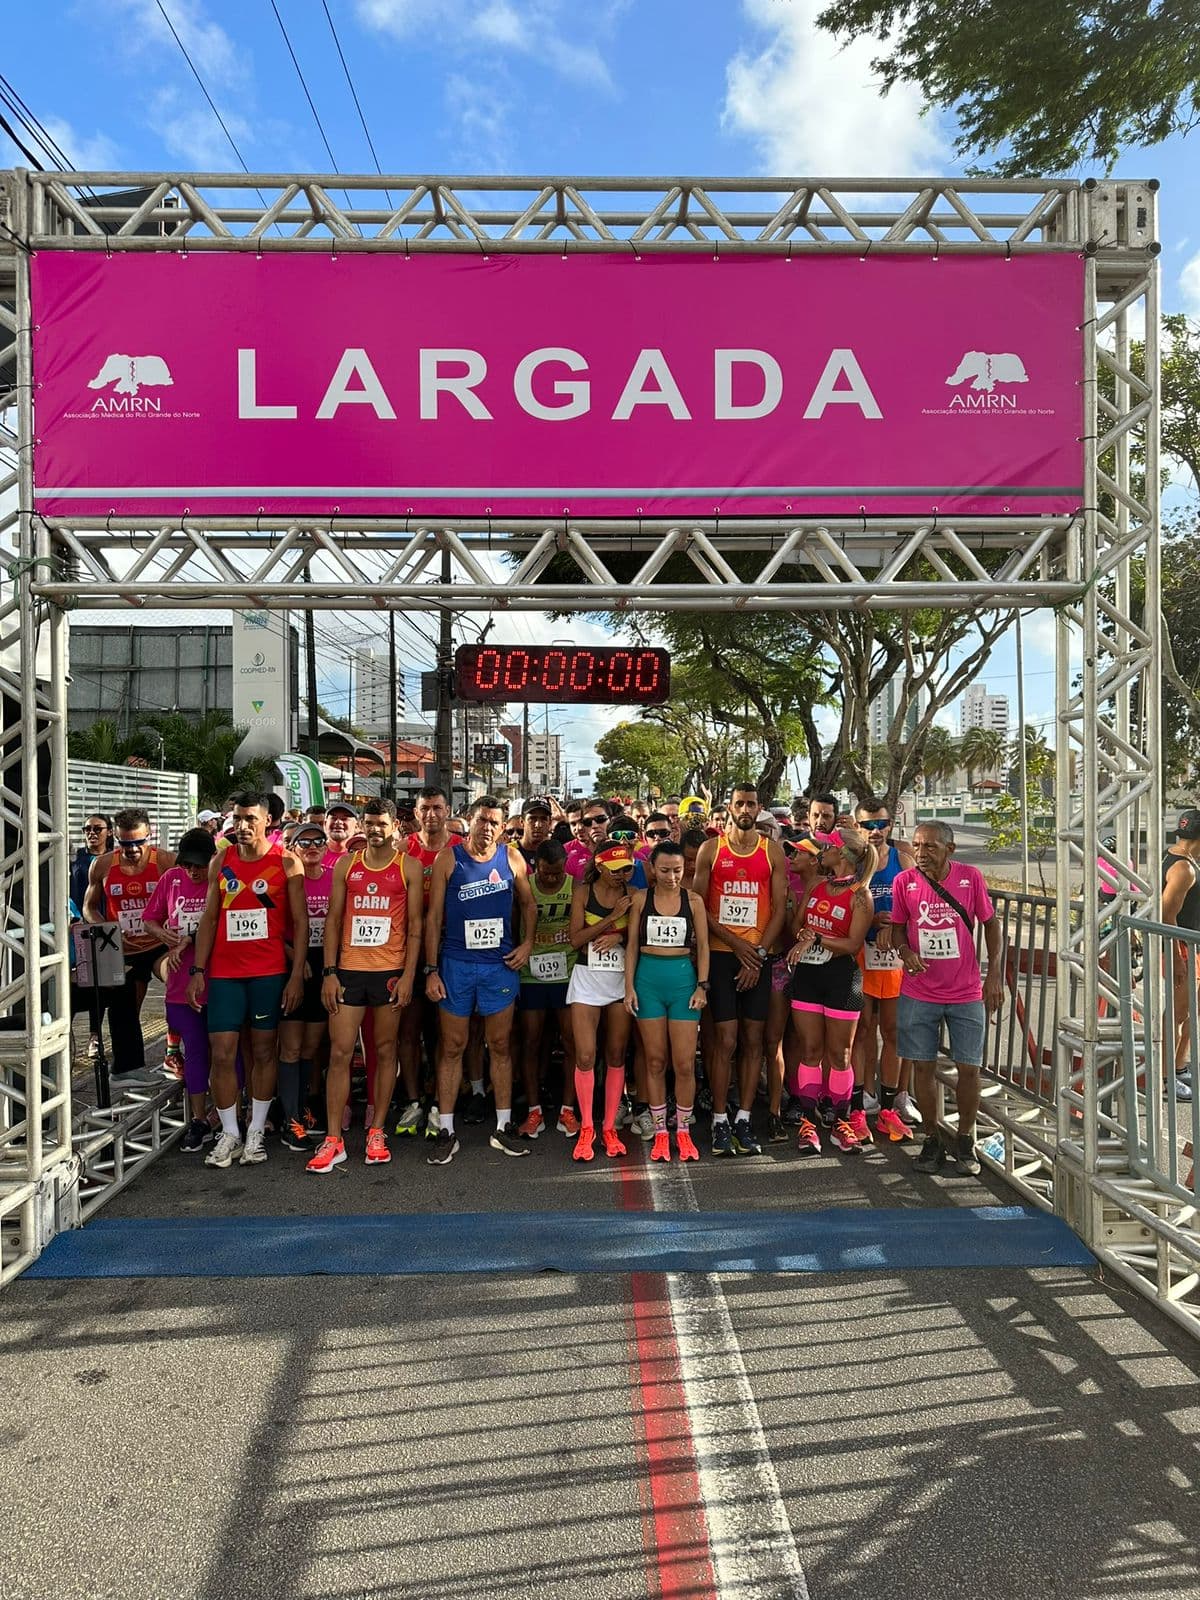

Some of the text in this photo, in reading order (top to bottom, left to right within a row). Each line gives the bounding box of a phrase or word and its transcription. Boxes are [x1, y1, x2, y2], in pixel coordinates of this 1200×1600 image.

[237, 347, 884, 421] LARGADA
[91, 397, 161, 411] AMRN
[949, 394, 1017, 408] AMRN
[475, 650, 660, 691] 00:00:00
[723, 881, 759, 895] CARN
[354, 895, 390, 910] CARN
[727, 905, 749, 917] 397
[236, 919, 258, 931] 196
[807, 913, 833, 930] CARN
[359, 926, 381, 937] 037
[474, 928, 496, 939] 025
[657, 926, 678, 937] 143
[928, 939, 951, 950] 211
[598, 952, 618, 962] 136
[874, 950, 895, 961] 373
[539, 961, 559, 973] 039
